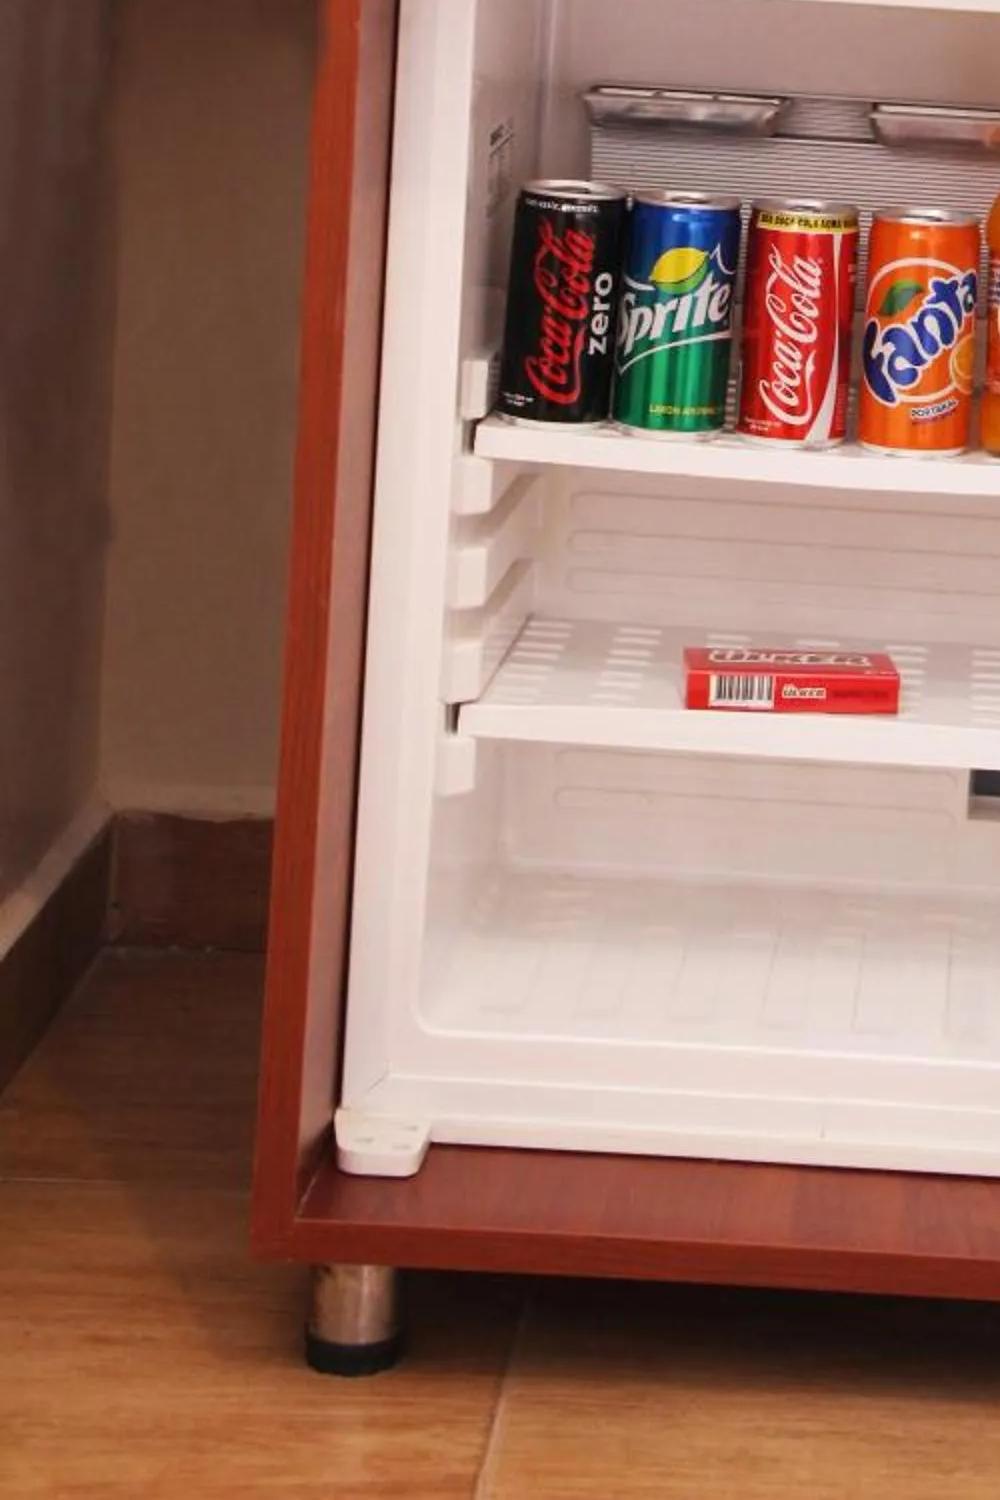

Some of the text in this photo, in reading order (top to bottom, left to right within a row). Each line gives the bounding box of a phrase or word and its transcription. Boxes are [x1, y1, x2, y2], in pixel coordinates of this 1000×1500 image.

[587, 272, 614, 356] zero
[616, 271, 732, 356] Sprite
[863, 270, 979, 404] Fanta
